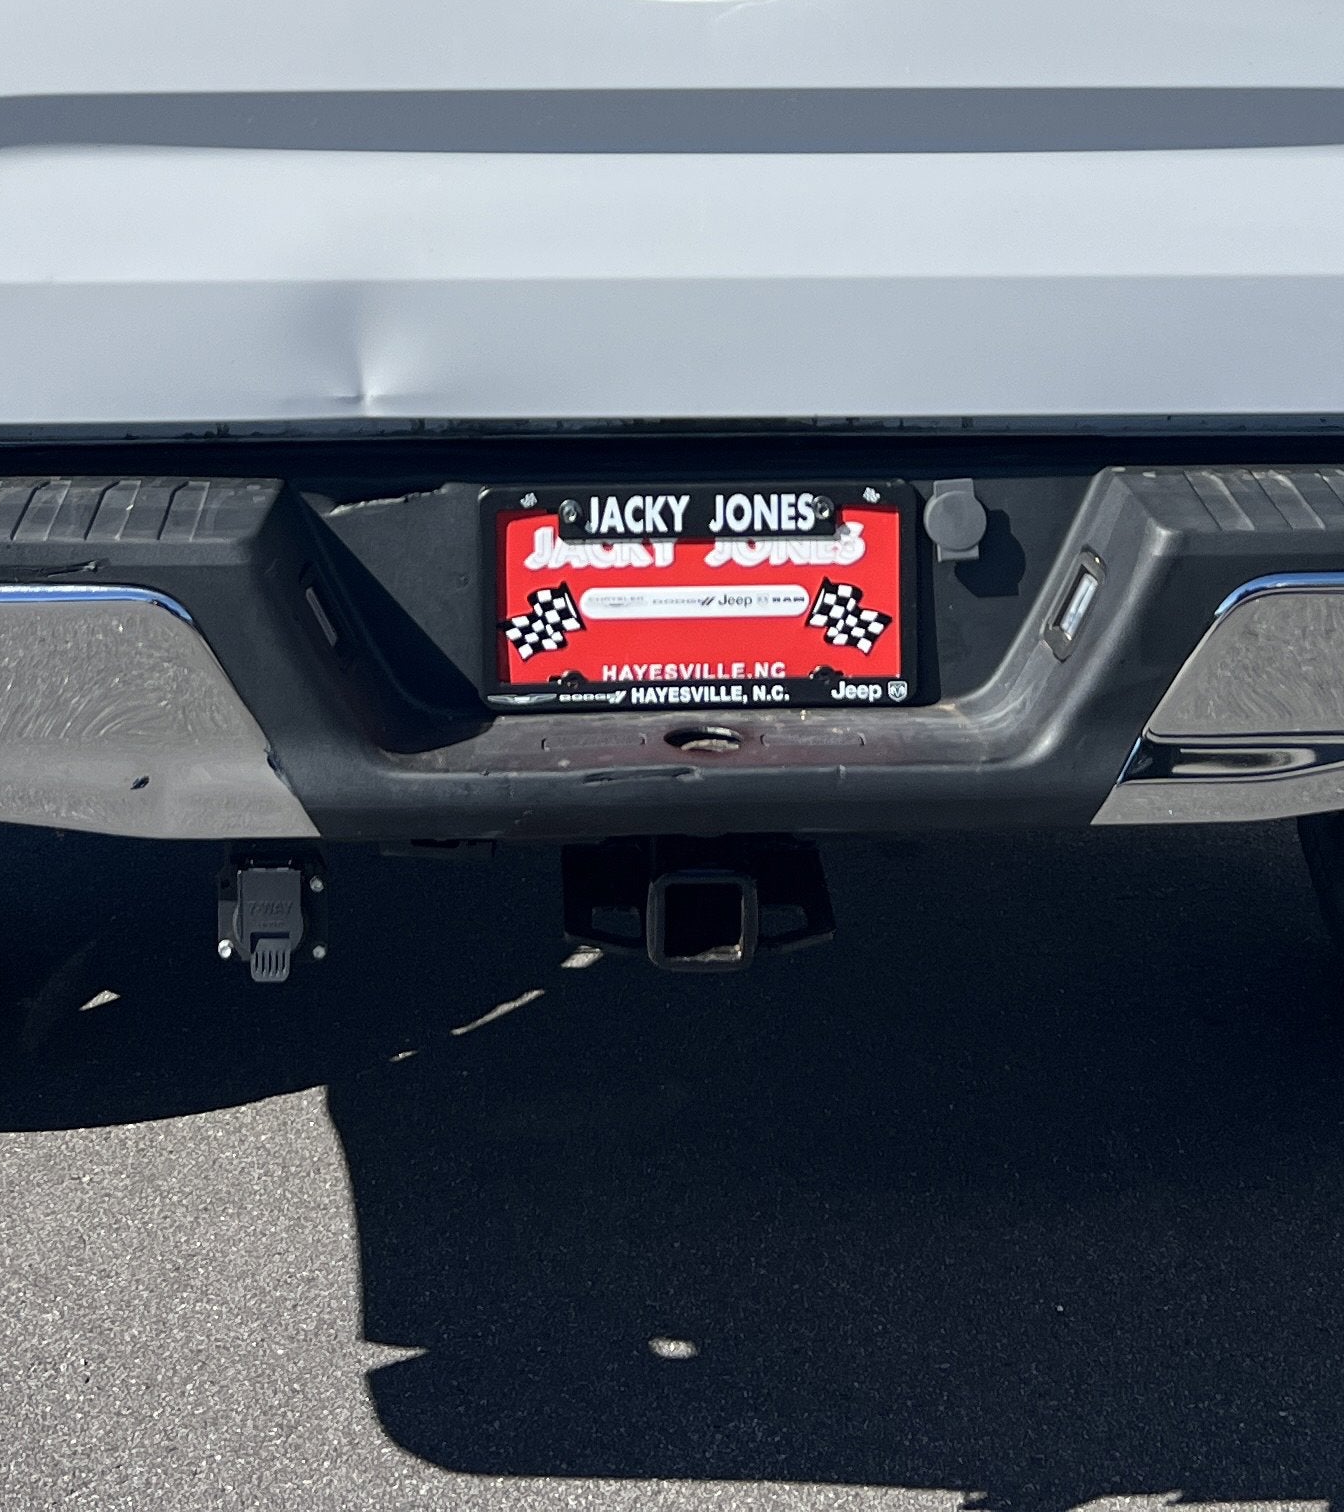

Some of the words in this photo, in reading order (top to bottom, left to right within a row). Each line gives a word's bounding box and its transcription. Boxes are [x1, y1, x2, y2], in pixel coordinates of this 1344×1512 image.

[585, 495, 691, 535] JACKY
[709, 493, 816, 533] JONES
[524, 526, 680, 571] JACKY
[704, 522, 867, 569] JONES
[718, 594, 753, 608] Jeep
[631, 686, 748, 704] HAYESVILLE,
[753, 685, 790, 702] N.C.
[830, 680, 883, 703] Jeep
